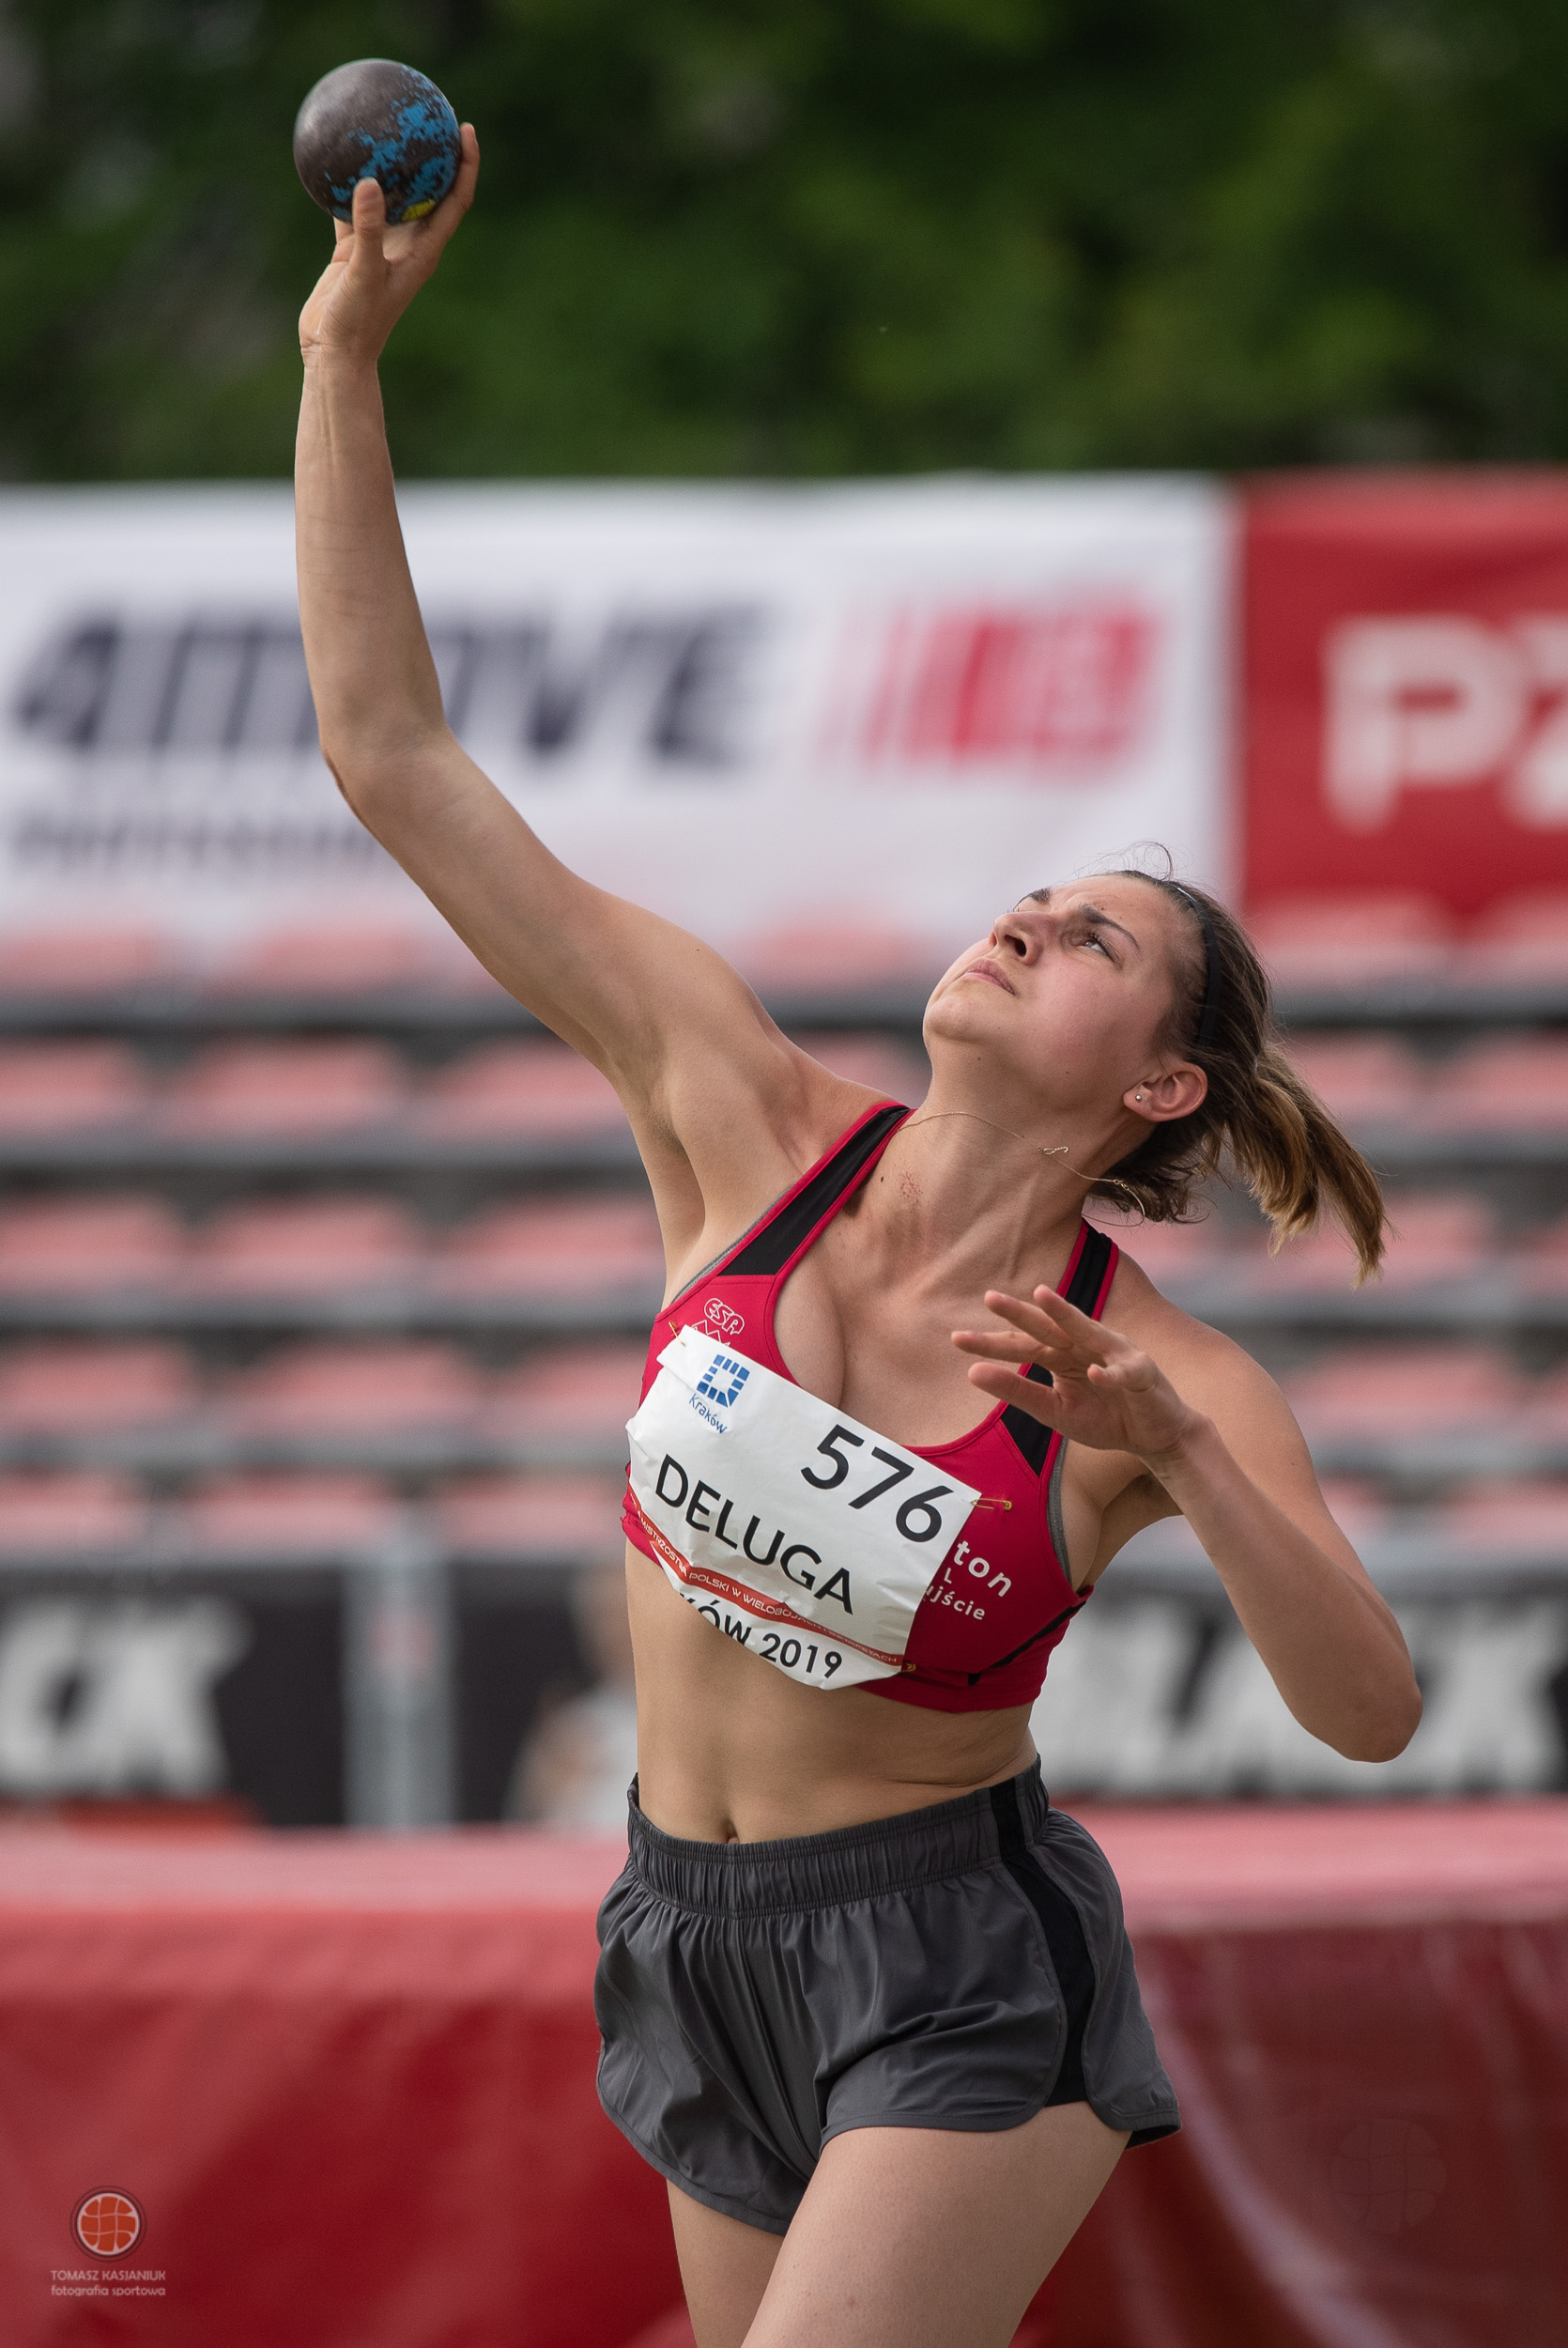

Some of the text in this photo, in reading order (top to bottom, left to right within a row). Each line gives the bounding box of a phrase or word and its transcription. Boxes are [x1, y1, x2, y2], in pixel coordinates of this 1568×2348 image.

[688, 1393, 728, 1434] Kraków
[800, 1424, 954, 1543] 576
[654, 1453, 854, 1615] DELUGA
[688, 1572, 730, 1593] POLSKI
[731, 1586, 742, 1598] W
[679, 1592, 843, 1679] ÓW 2019
